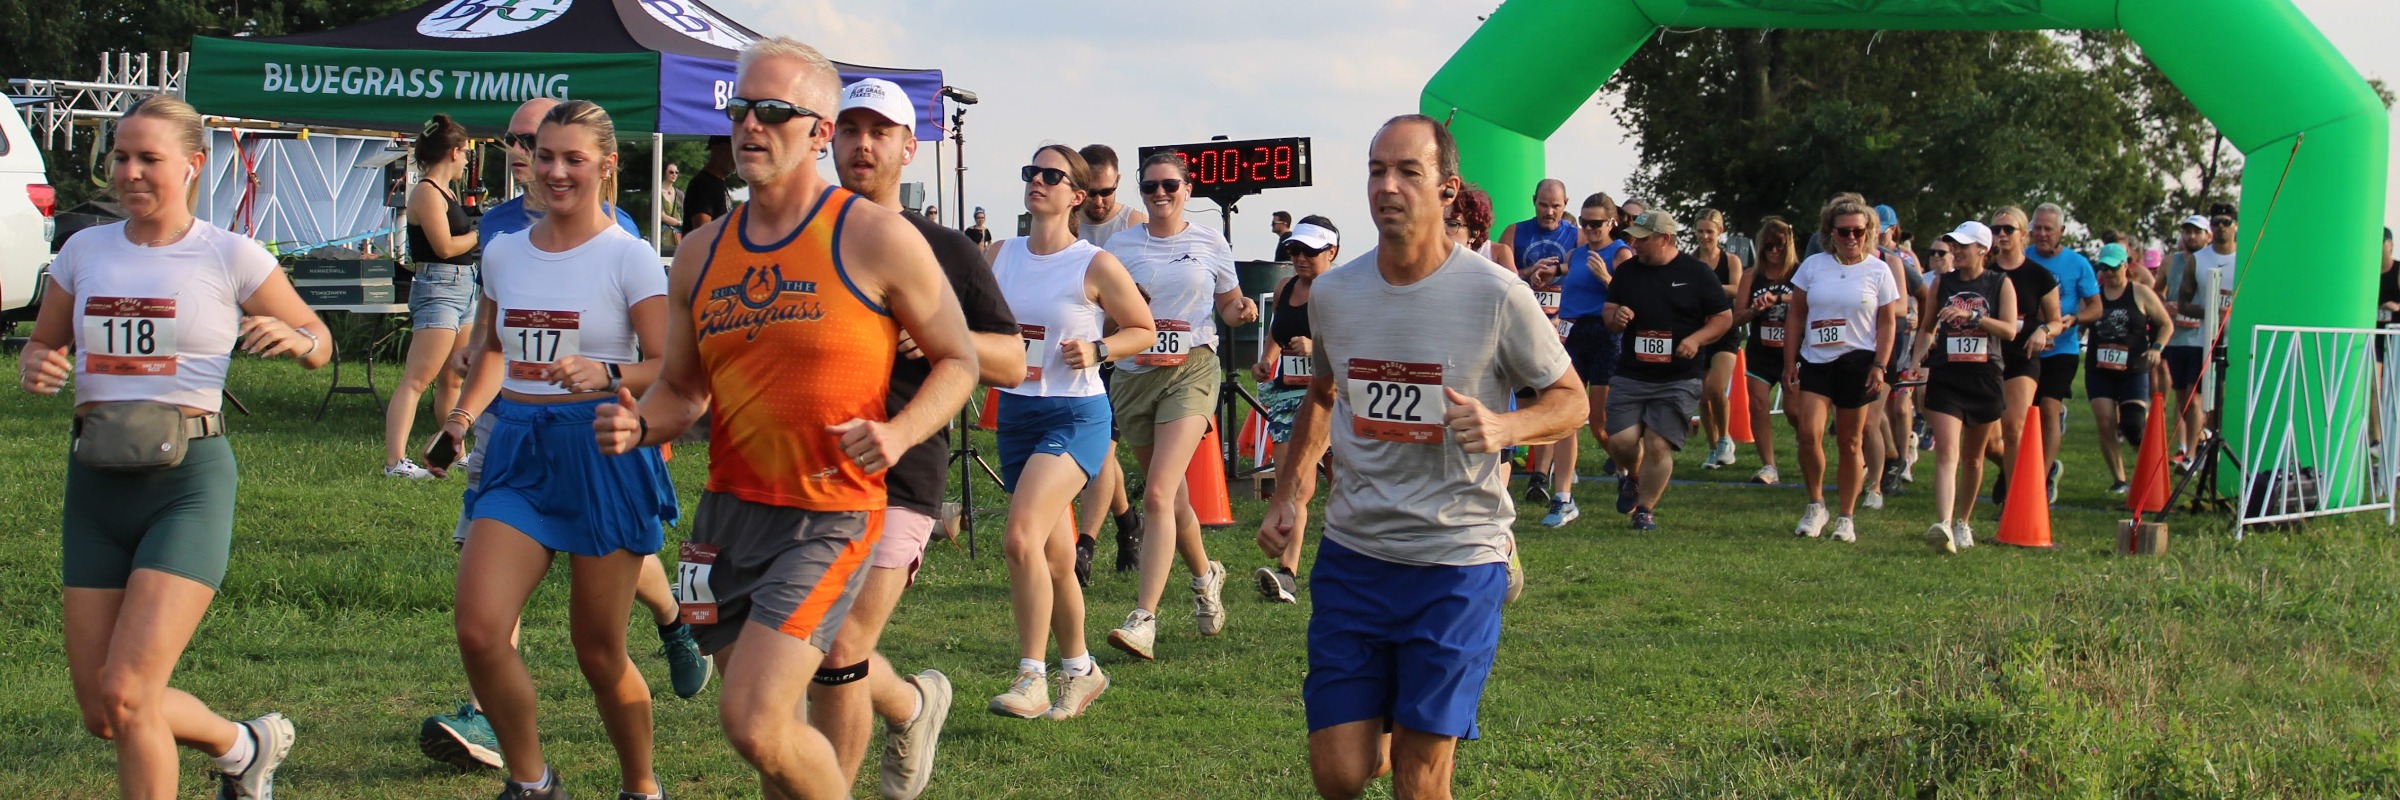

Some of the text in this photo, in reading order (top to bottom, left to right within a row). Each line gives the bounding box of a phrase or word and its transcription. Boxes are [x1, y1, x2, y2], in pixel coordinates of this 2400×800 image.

[263, 62, 570, 101] BLUEGRASS TIMING
[713, 281, 812, 299] RUN THE
[699, 299, 823, 343] Bluegrass
[103, 318, 155, 355] 118
[518, 329, 561, 362] 117
[1150, 332, 1179, 353] 36
[1818, 327, 1838, 343] 138
[1956, 338, 1979, 353] 137
[1642, 338, 1664, 354] 168
[2104, 353, 2121, 363] 167
[1367, 382, 1421, 421] 222
